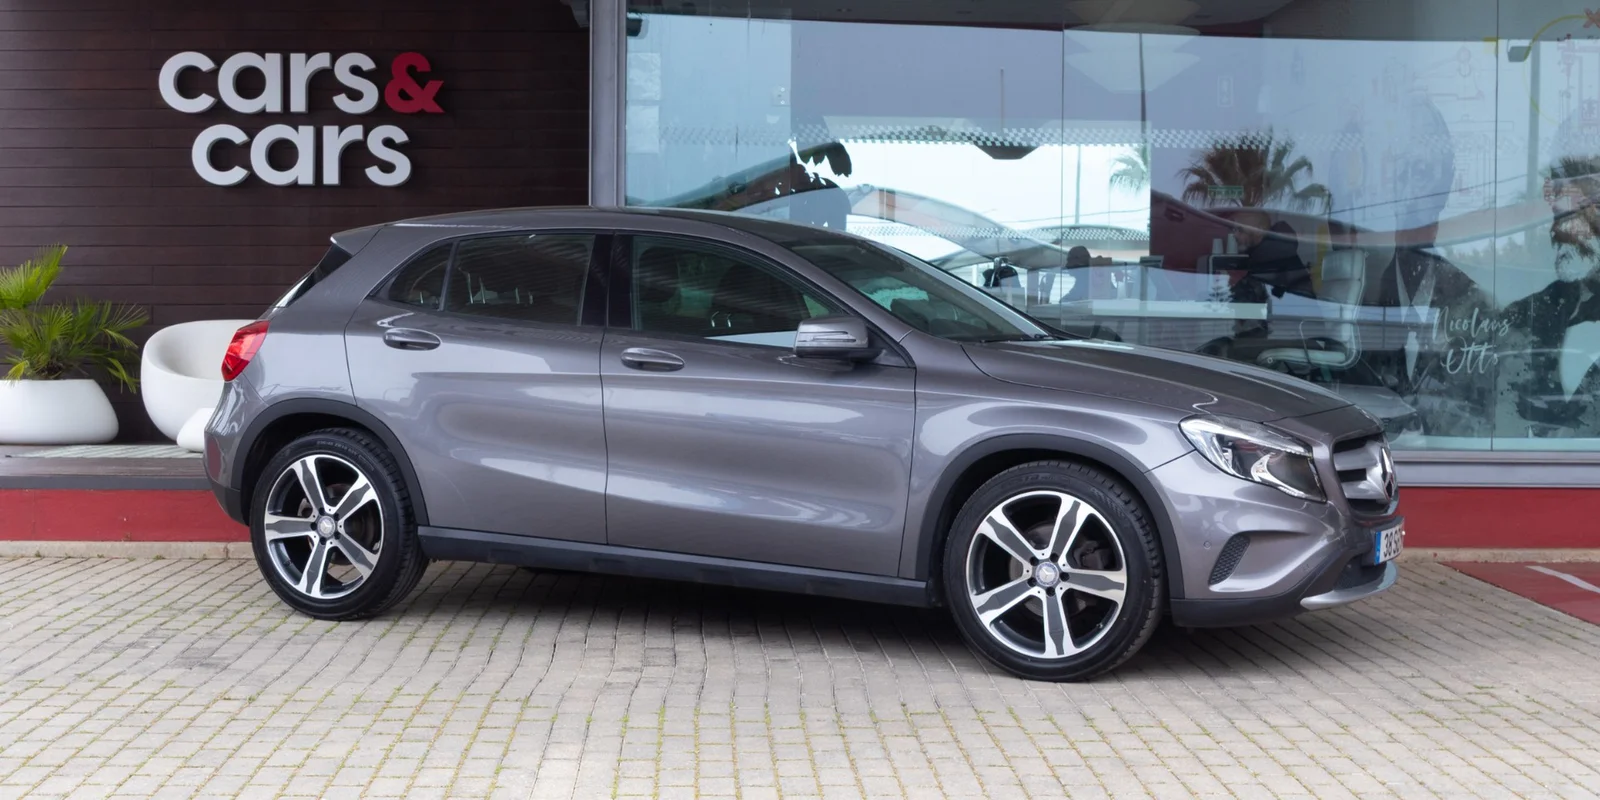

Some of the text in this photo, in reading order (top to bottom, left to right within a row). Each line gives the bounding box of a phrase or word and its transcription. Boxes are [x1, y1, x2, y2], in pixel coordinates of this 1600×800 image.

[158, 51, 445, 114] cars&
[191, 123, 412, 186] cars
[1440, 336, 1499, 374] Otto
